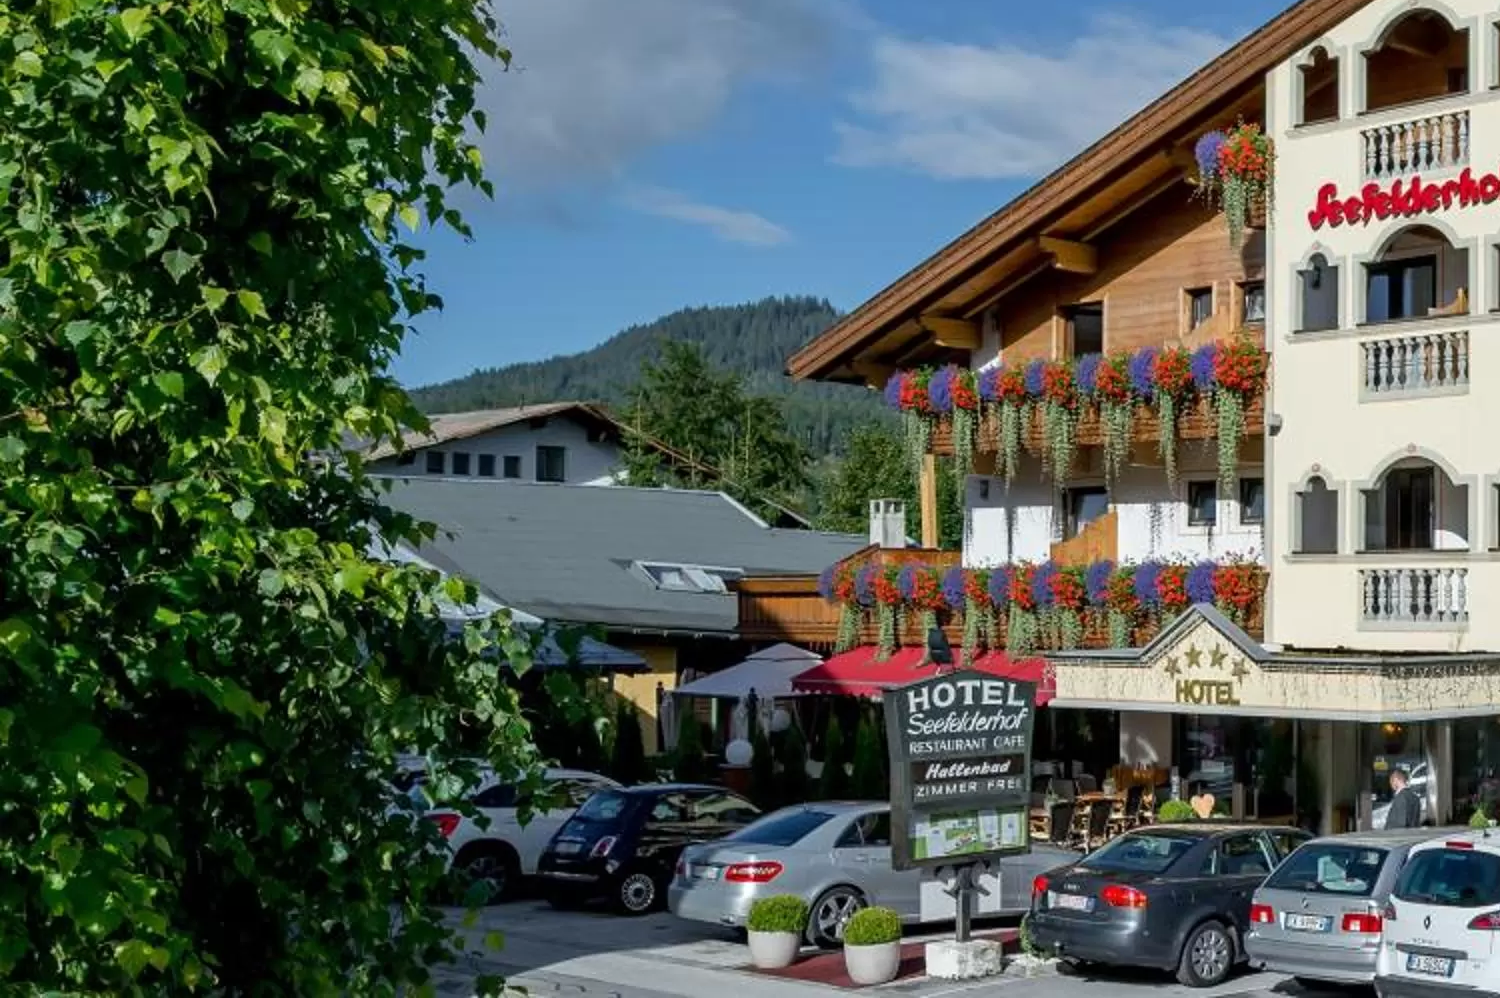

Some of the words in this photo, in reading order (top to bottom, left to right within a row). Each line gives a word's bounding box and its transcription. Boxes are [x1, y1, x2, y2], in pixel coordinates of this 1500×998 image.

[908, 680, 1025, 713] HOTEL
[1176, 679, 1241, 705] HOTEL
[908, 708, 1028, 735] Seefelderhof
[909, 737, 987, 754] RESTAURANT
[993, 735, 1025, 748] CAFE
[916, 783, 977, 797] ZIMMER
[987, 777, 1023, 791] FREI
